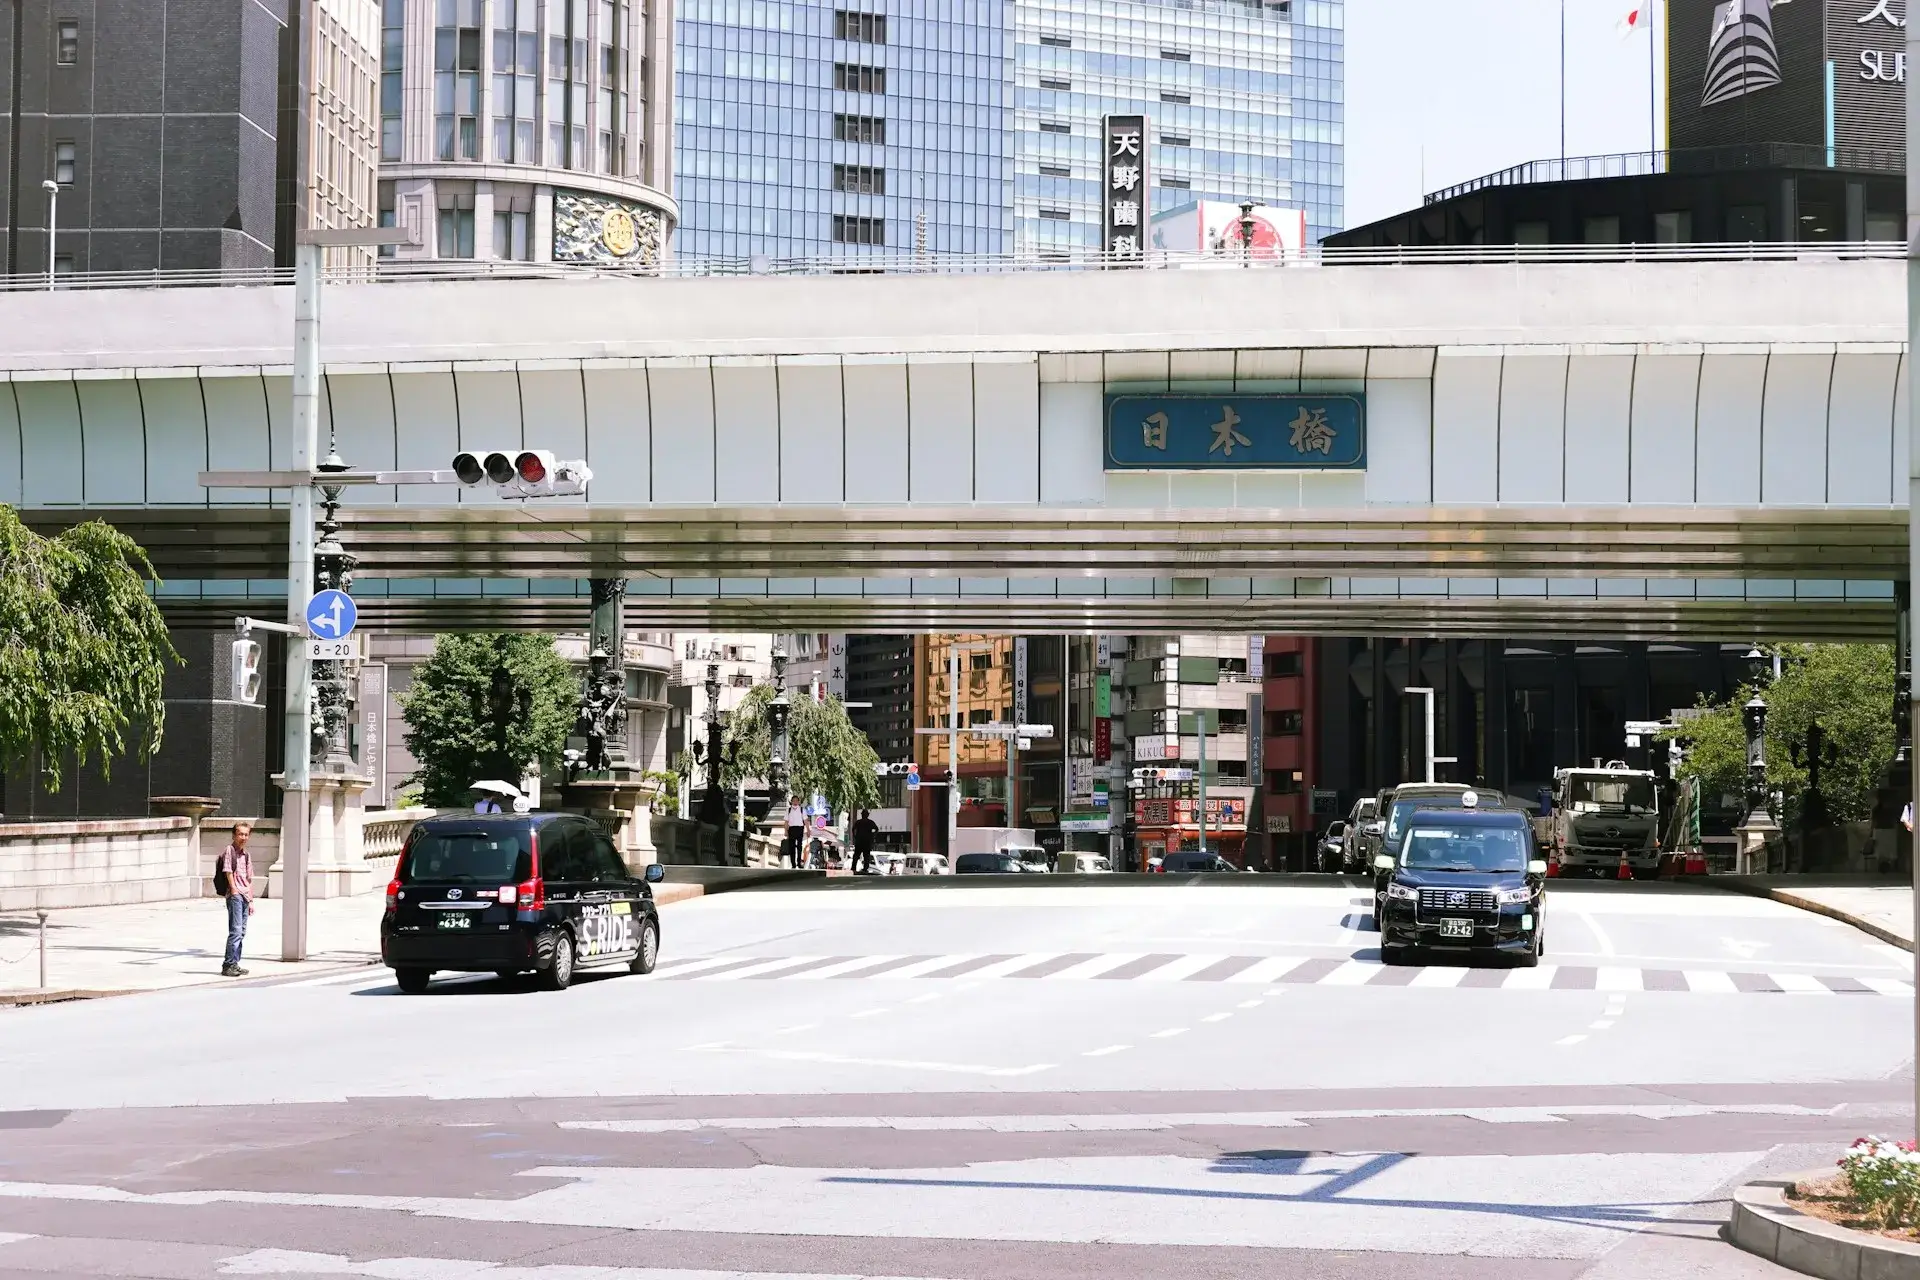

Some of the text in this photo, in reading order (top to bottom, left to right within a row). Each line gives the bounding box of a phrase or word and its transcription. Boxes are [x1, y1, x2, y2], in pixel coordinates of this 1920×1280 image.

[1141, 404, 1337, 456] 日本橋
[313, 644, 350, 656] 8-20
[1447, 924, 1471, 935] 73-42
